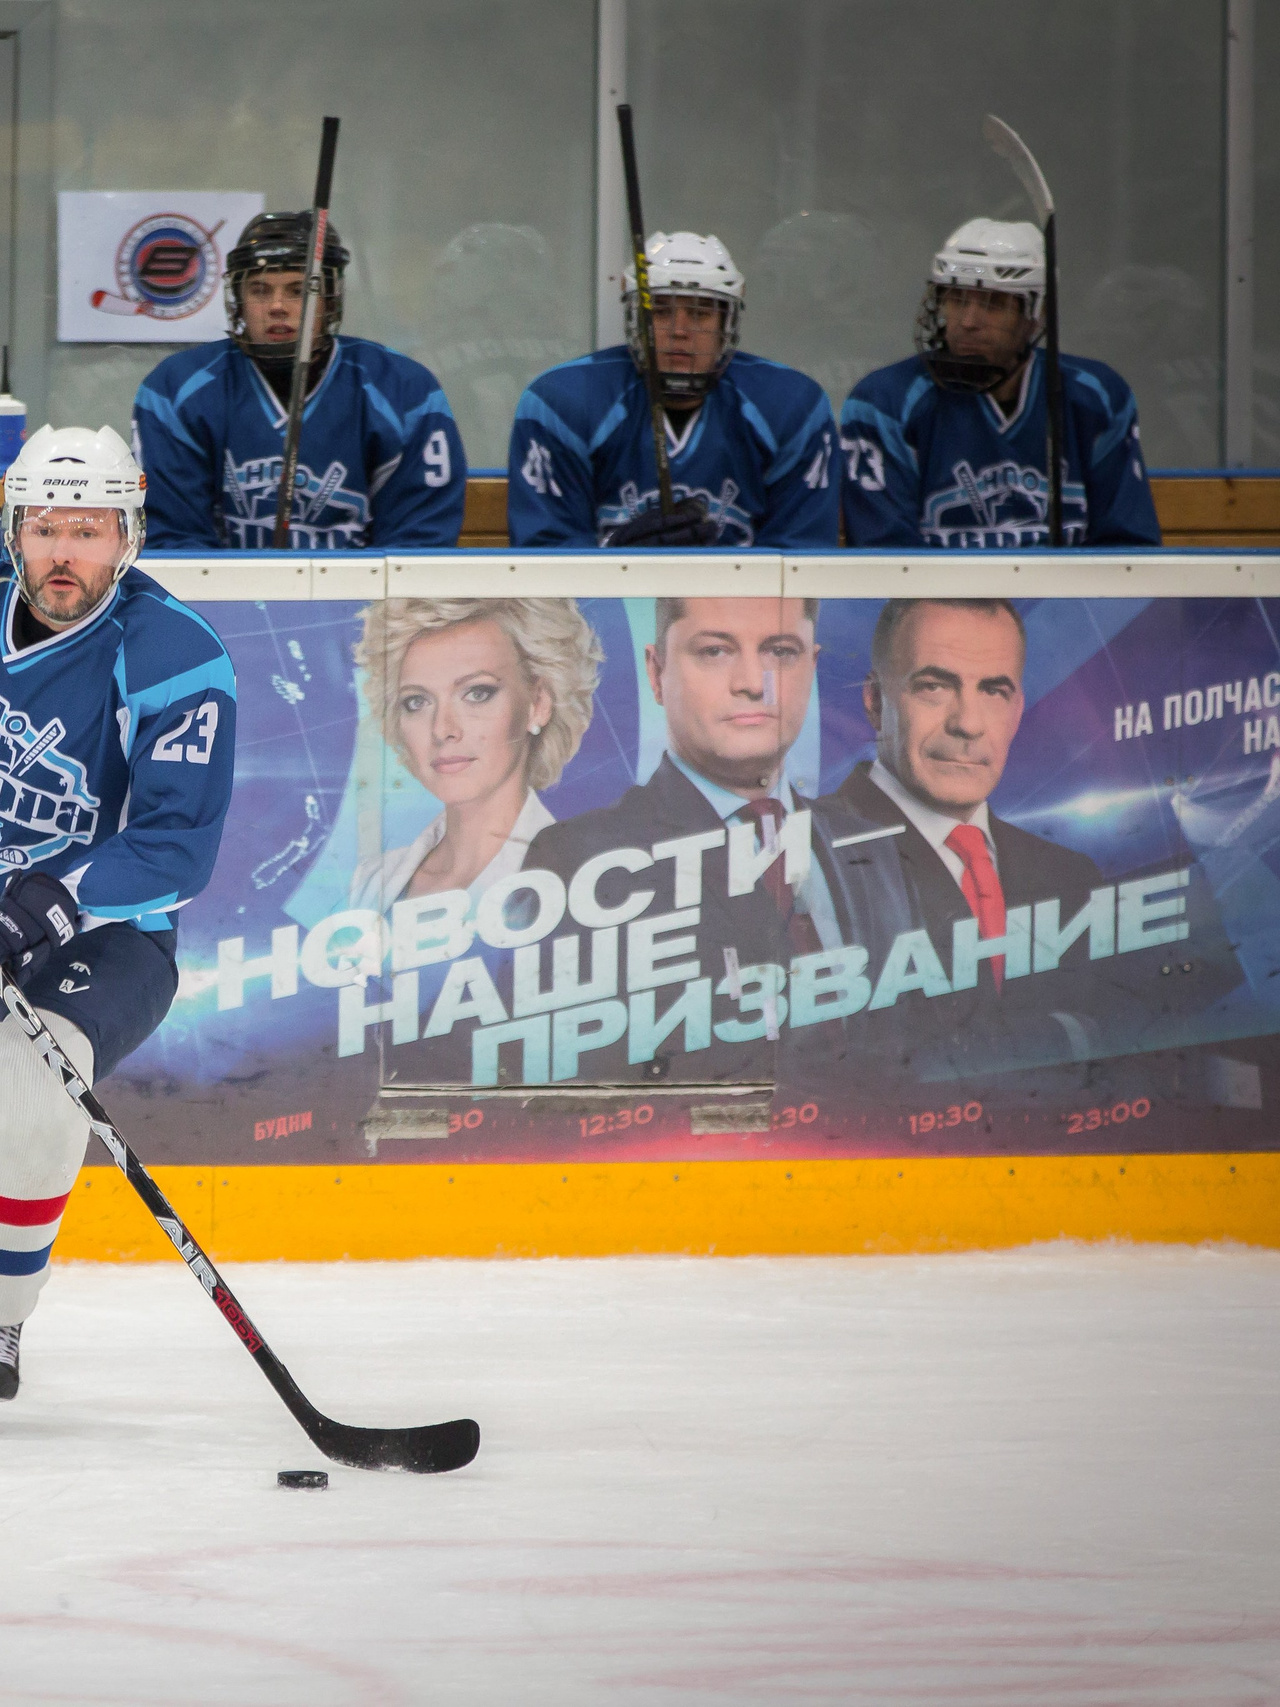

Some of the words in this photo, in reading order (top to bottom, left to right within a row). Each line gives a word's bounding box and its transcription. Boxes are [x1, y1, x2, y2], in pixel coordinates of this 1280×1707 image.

[42, 478, 89, 488] BAUER
[150, 701, 219, 765] 23
[1114, 700, 1154, 742] НА
[1163, 671, 1280, 731] ПОЛЧАС
[1243, 715, 1280, 755] НА
[217, 809, 813, 1011] НОВОСТИ
[337, 907, 702, 1059] НАШЕ
[471, 869, 1190, 1087] ПРИЗВАНИЕ
[253, 1110, 313, 1141] БУДНИ
[579, 1104, 655, 1138] 12:30
[908, 1100, 984, 1135] 19:30
[1066, 1097, 1152, 1135] 23:00
